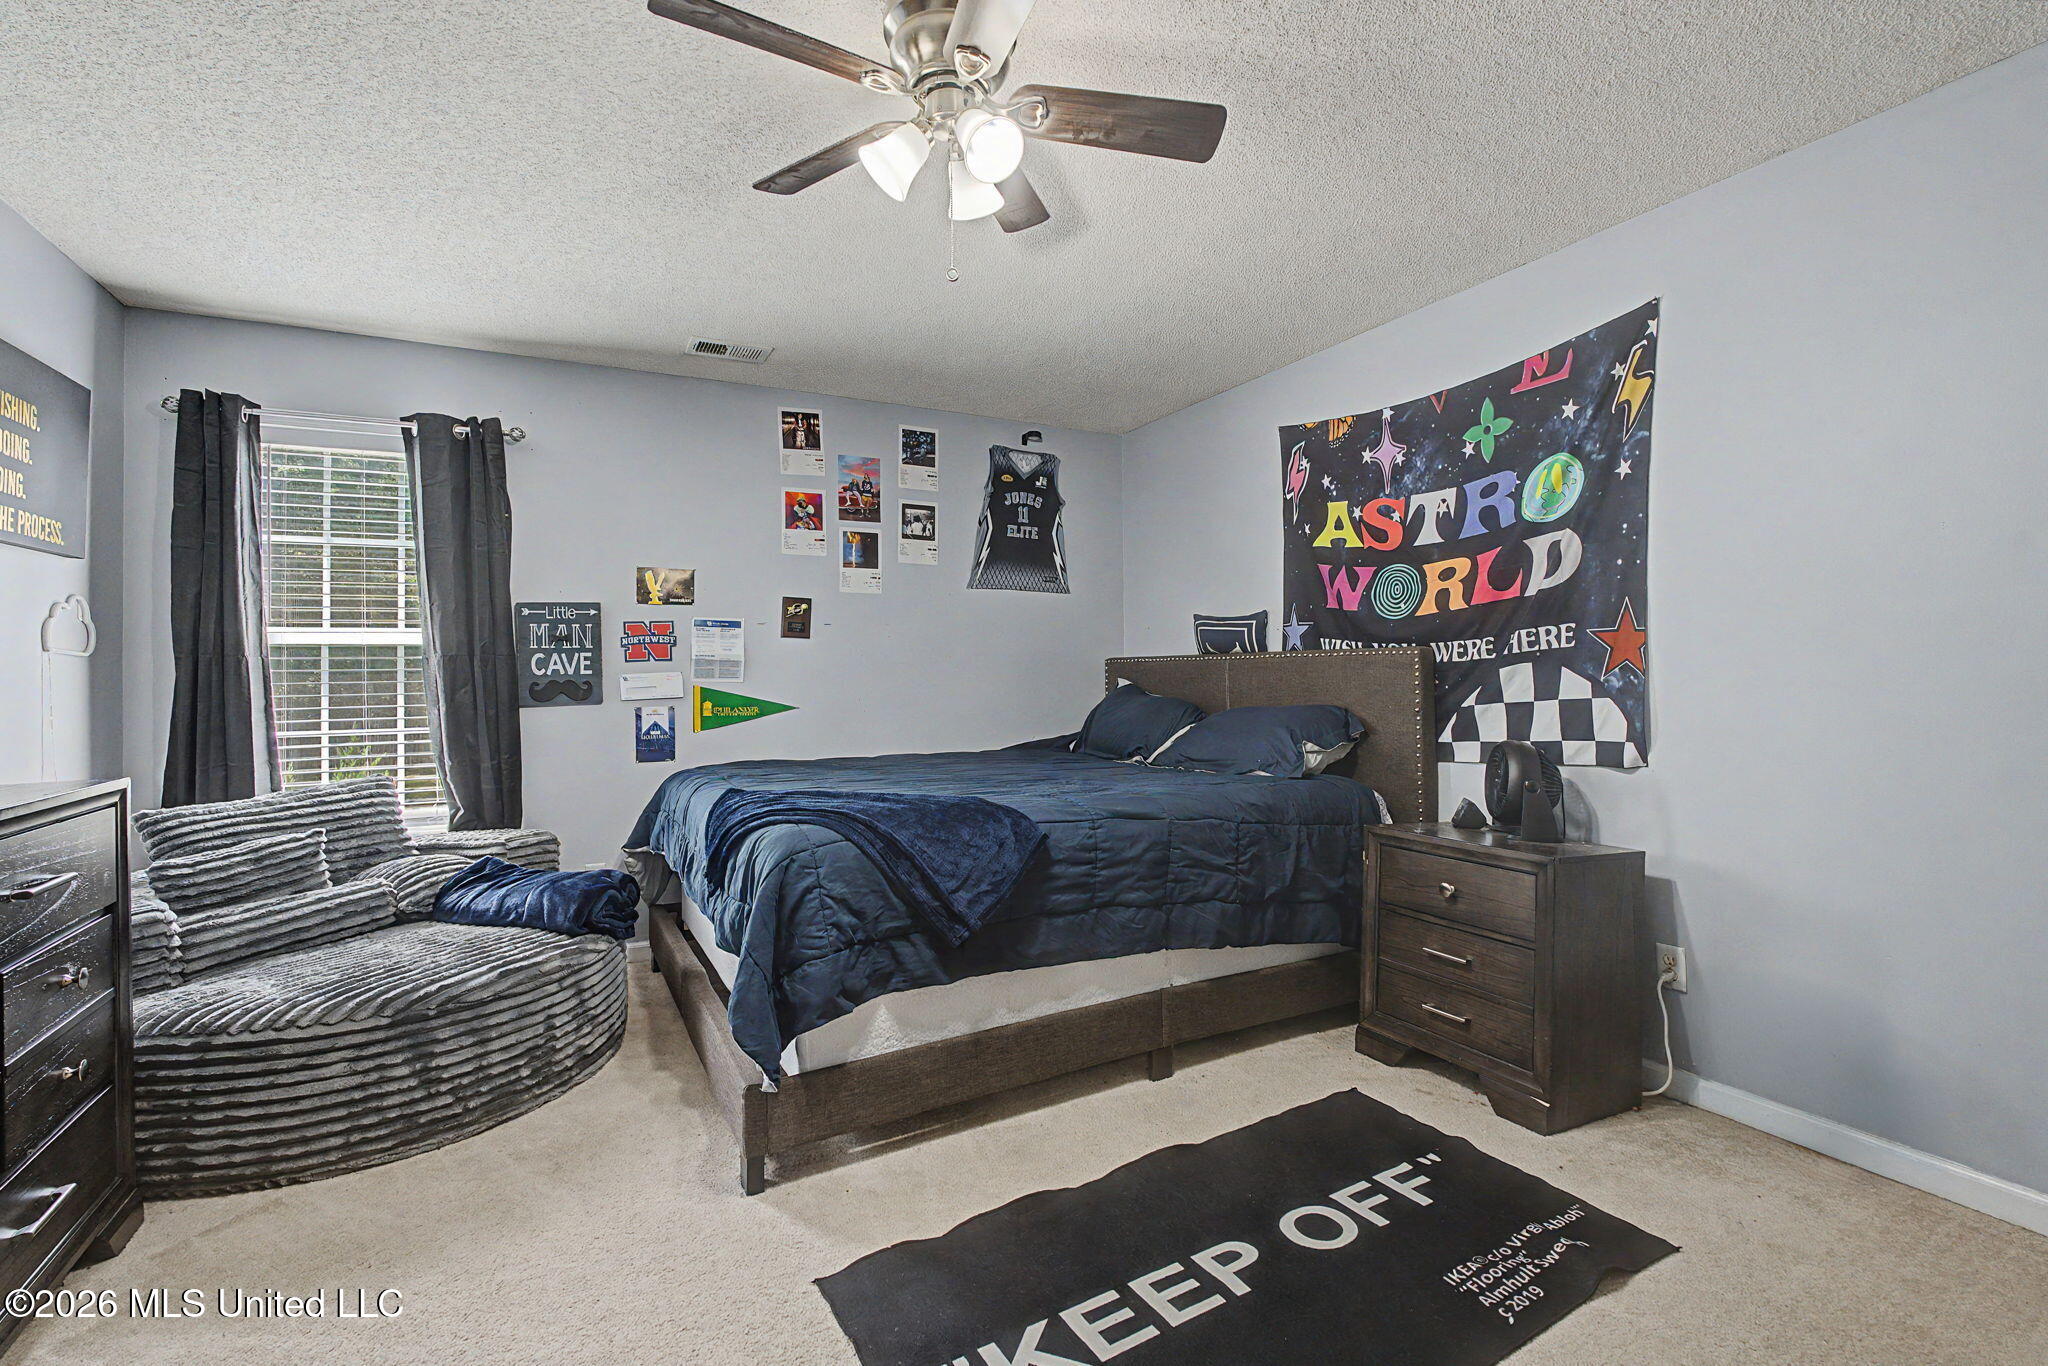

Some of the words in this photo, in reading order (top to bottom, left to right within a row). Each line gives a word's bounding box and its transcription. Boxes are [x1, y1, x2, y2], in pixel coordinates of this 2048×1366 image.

[0, 389, 41, 432] ISHING.
[1004, 491, 1043, 509] JONES
[1313, 452, 1585, 552] ASTRO
[0, 505, 15, 532] HE
[17, 509, 65, 546] PROCESS.
[1017, 506, 1029, 523] 11
[1007, 524, 1039, 540] ELITE
[1317, 527, 1583, 619] WORLD
[545, 606, 576, 619] Little
[529, 623, 593, 648] MAN
[1430, 636, 1497, 662] WERE
[531, 652, 593, 676] CAVE
[1278, 1152, 1443, 1250] OFF"
[1487, 1247, 1512, 1262] c/o
[1479, 1263, 1541, 1307] Almhult
[1505, 1285, 1545, 1312] 2019
